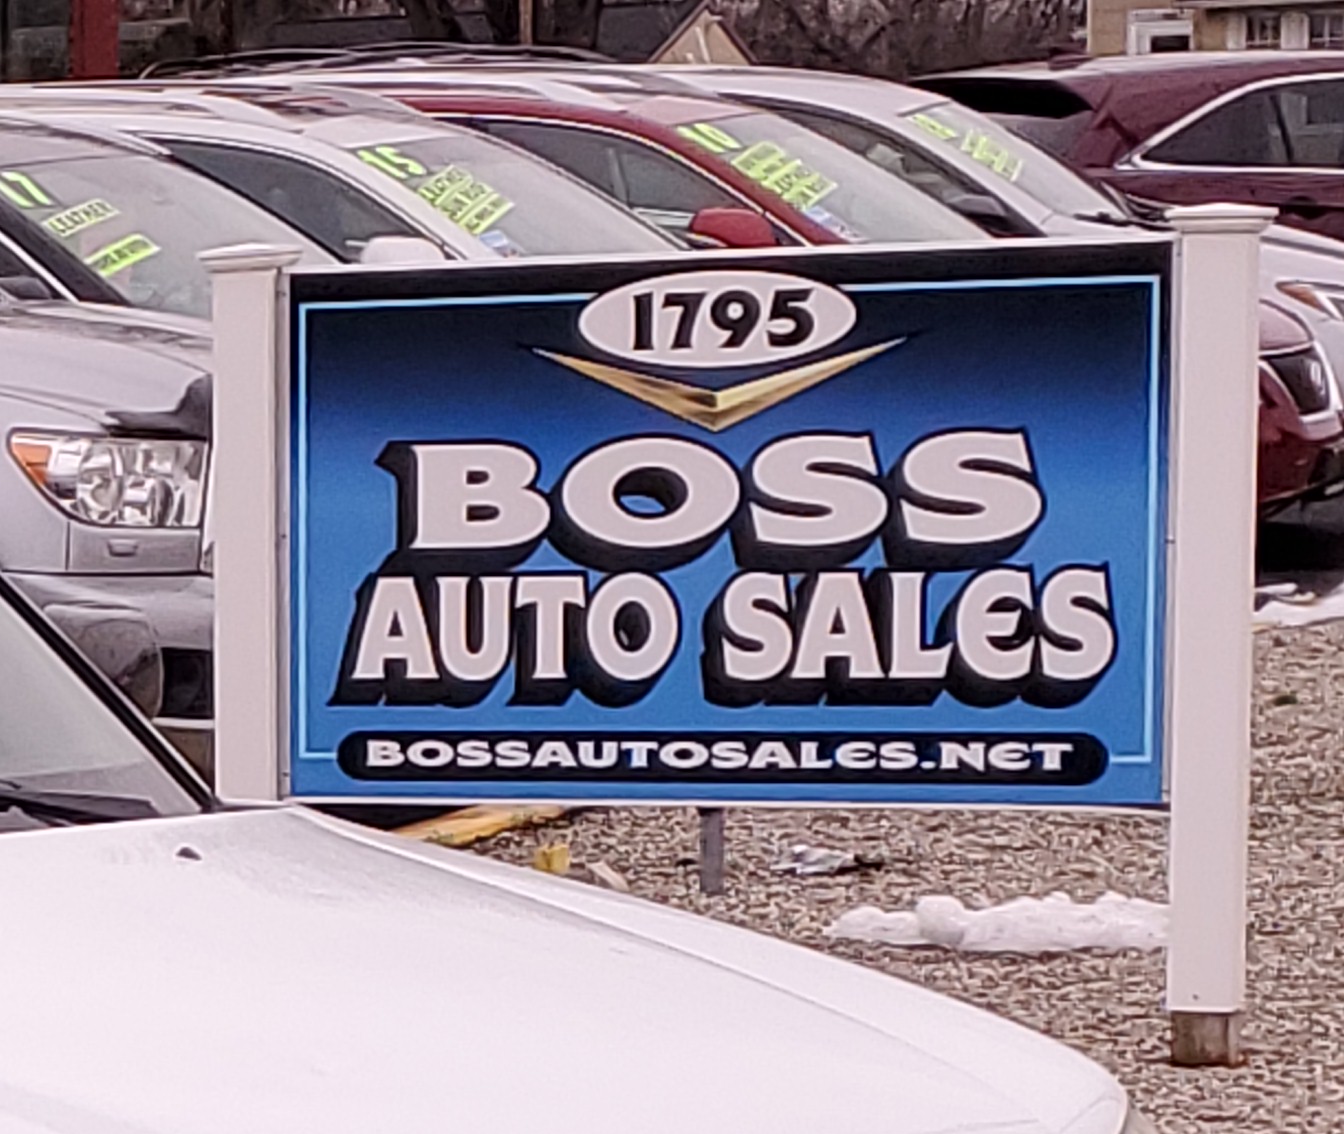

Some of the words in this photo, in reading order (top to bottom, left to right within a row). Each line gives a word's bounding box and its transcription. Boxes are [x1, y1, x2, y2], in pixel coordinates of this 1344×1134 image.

[357, 146, 428, 180] 15
[631, 287, 816, 351] 1795
[402, 429, 1046, 552] BOSS
[348, 571, 681, 682] AUTO
[719, 565, 1117, 682] SALES
[364, 739, 1074, 771] BOSSAUTOSALES.NET
